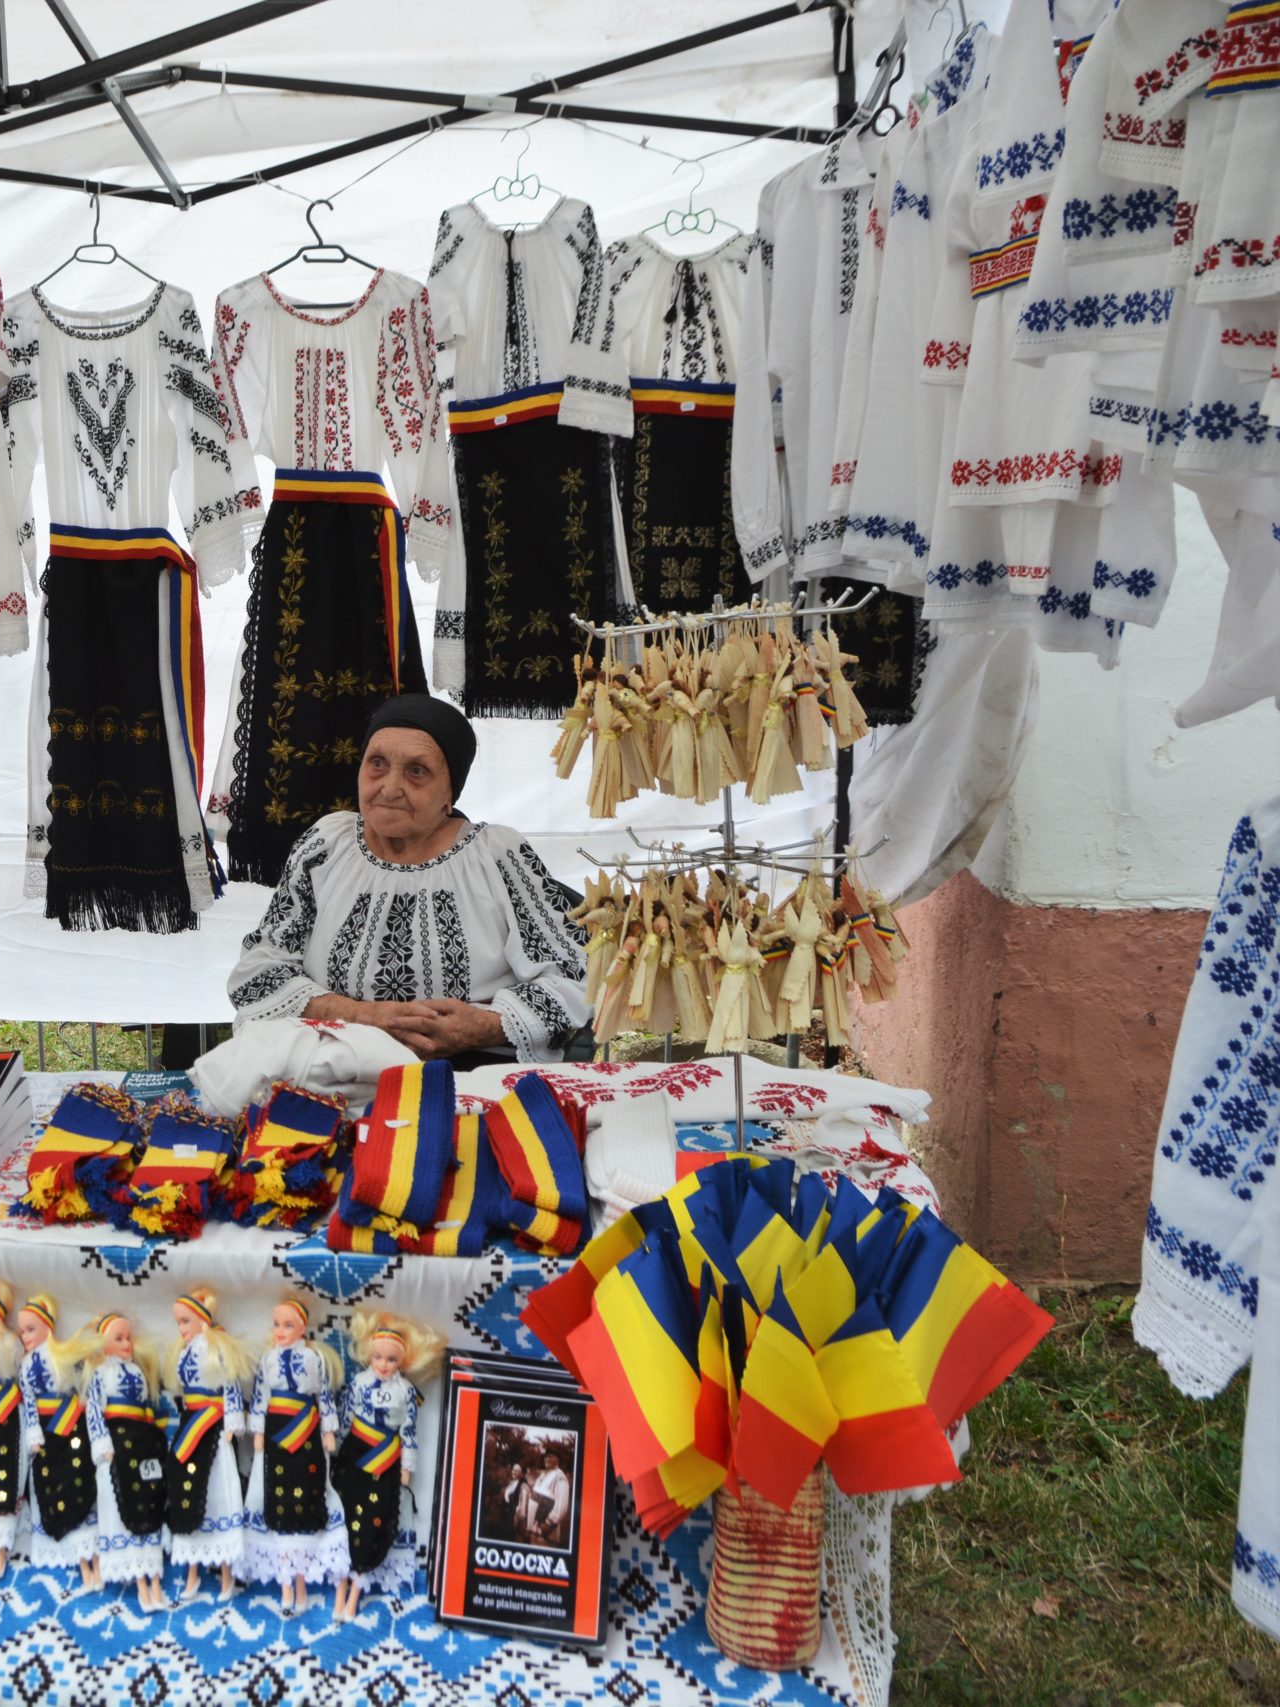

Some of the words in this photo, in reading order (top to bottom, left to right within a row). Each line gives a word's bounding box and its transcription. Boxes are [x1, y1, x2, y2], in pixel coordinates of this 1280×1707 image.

[474, 1546, 570, 1577] COJOCNA
[472, 1594, 483, 1605] de
[484, 1597, 495, 1607] pe
